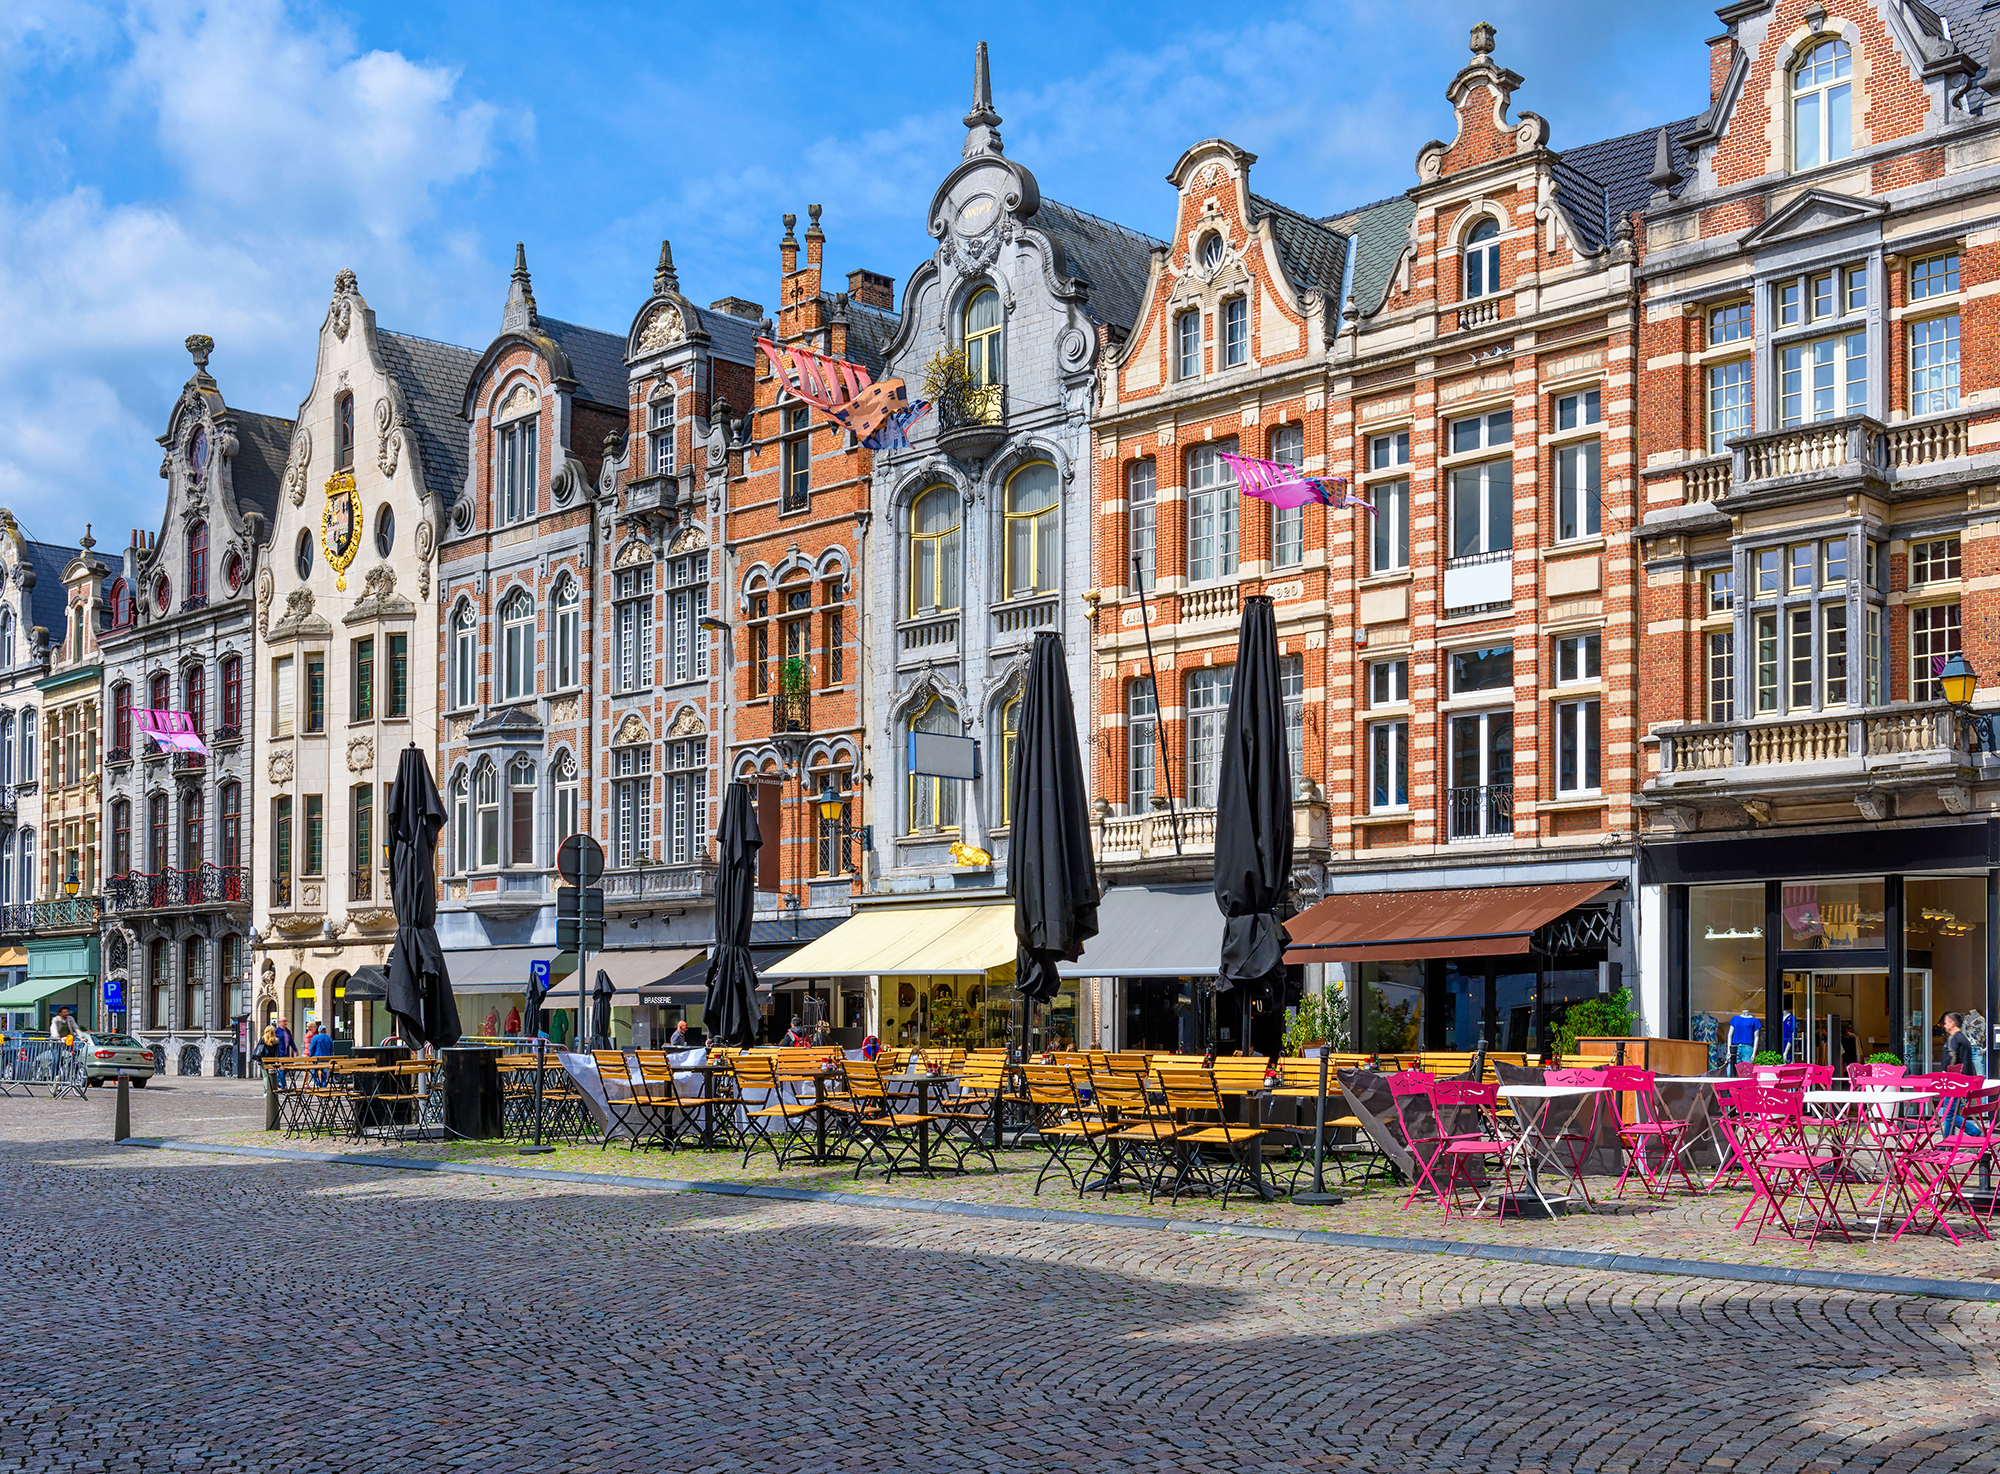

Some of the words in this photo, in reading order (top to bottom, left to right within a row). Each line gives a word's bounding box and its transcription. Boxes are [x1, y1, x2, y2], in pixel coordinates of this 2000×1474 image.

[1270, 585, 1298, 599] 1920
[107, 983, 117, 996] P
[643, 996, 672, 1004] BRASSERIE
